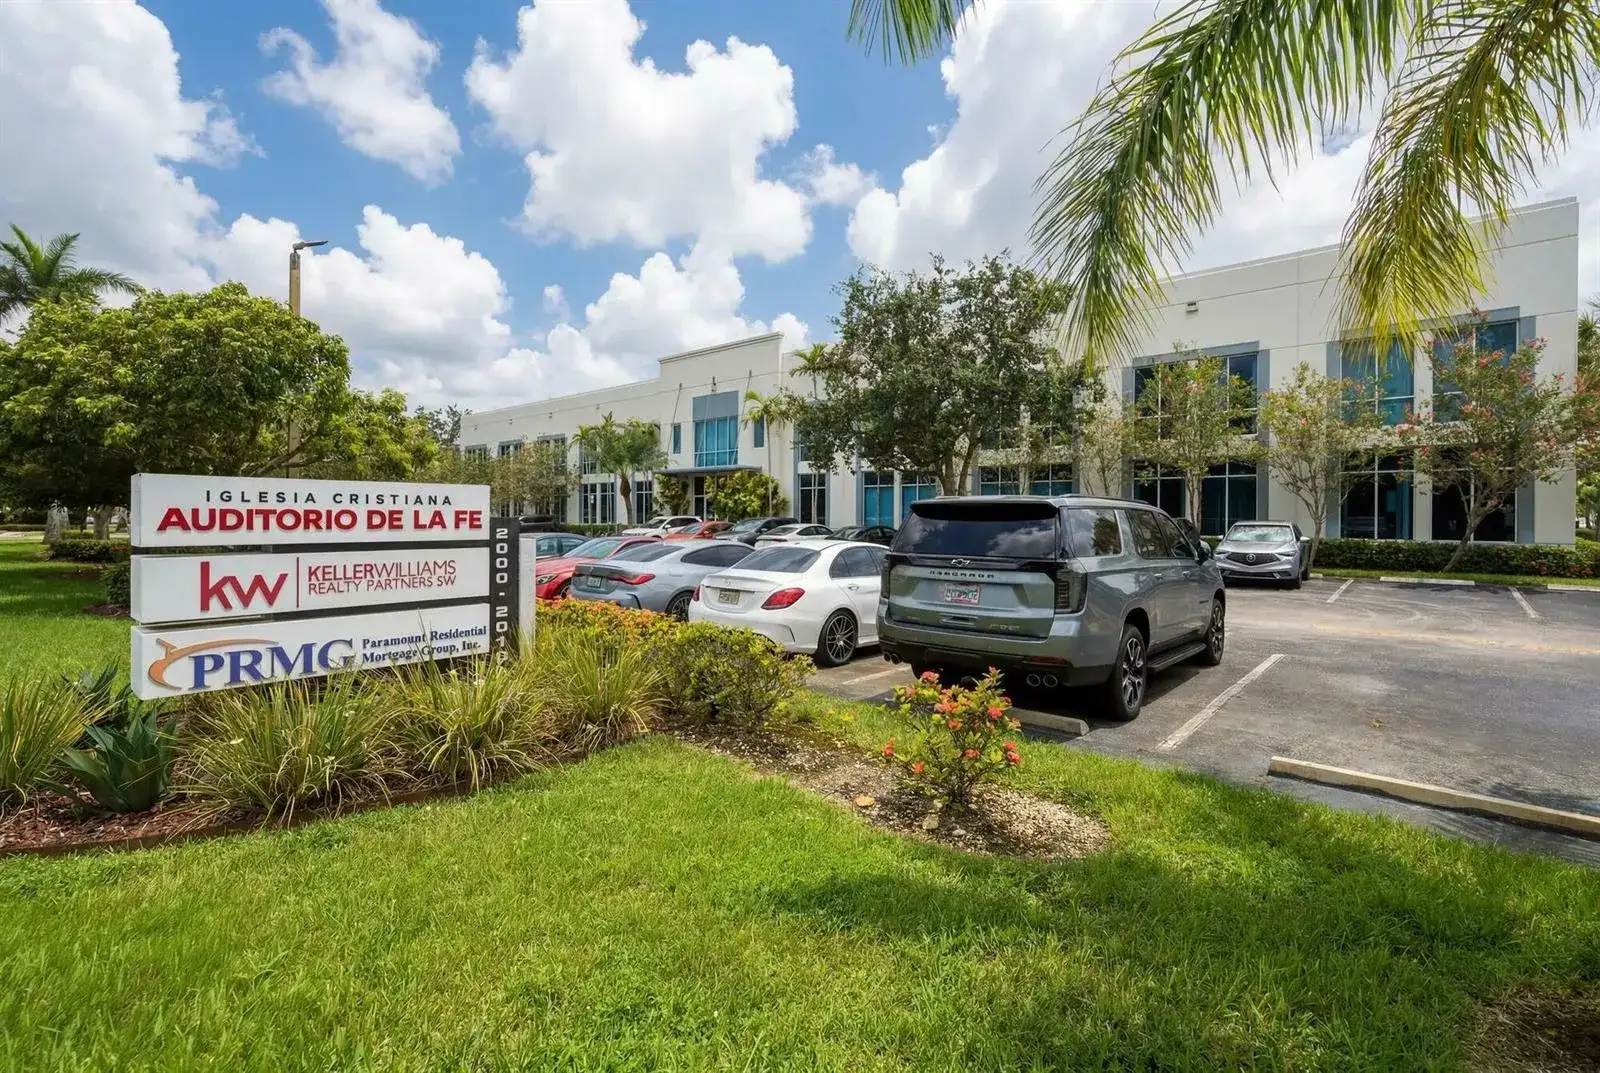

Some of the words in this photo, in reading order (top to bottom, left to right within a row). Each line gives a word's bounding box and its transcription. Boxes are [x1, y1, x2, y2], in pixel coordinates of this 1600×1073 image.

[206, 490, 316, 504] IGLESIA
[333, 492, 453, 506] CRISTIANA
[157, 507, 358, 532] AUDITORIO
[367, 509, 404, 531] DE
[413, 509, 446, 530] LA
[454, 510, 482, 529] FE
[496, 528, 508, 583] 2000
[200, 561, 288, 612] kw
[308, 580, 362, 595] REALTY
[366, 576, 433, 592] PARTNERS
[437, 575, 456, 587] SW
[362, 633, 426, 649] Paramount
[430, 625, 487, 641] Residential
[188, 638, 355, 690] PRMG
[362, 649, 418, 663] Mortgage
[421, 644, 459, 656] Group,
[462, 641, 481, 651] Inc.
